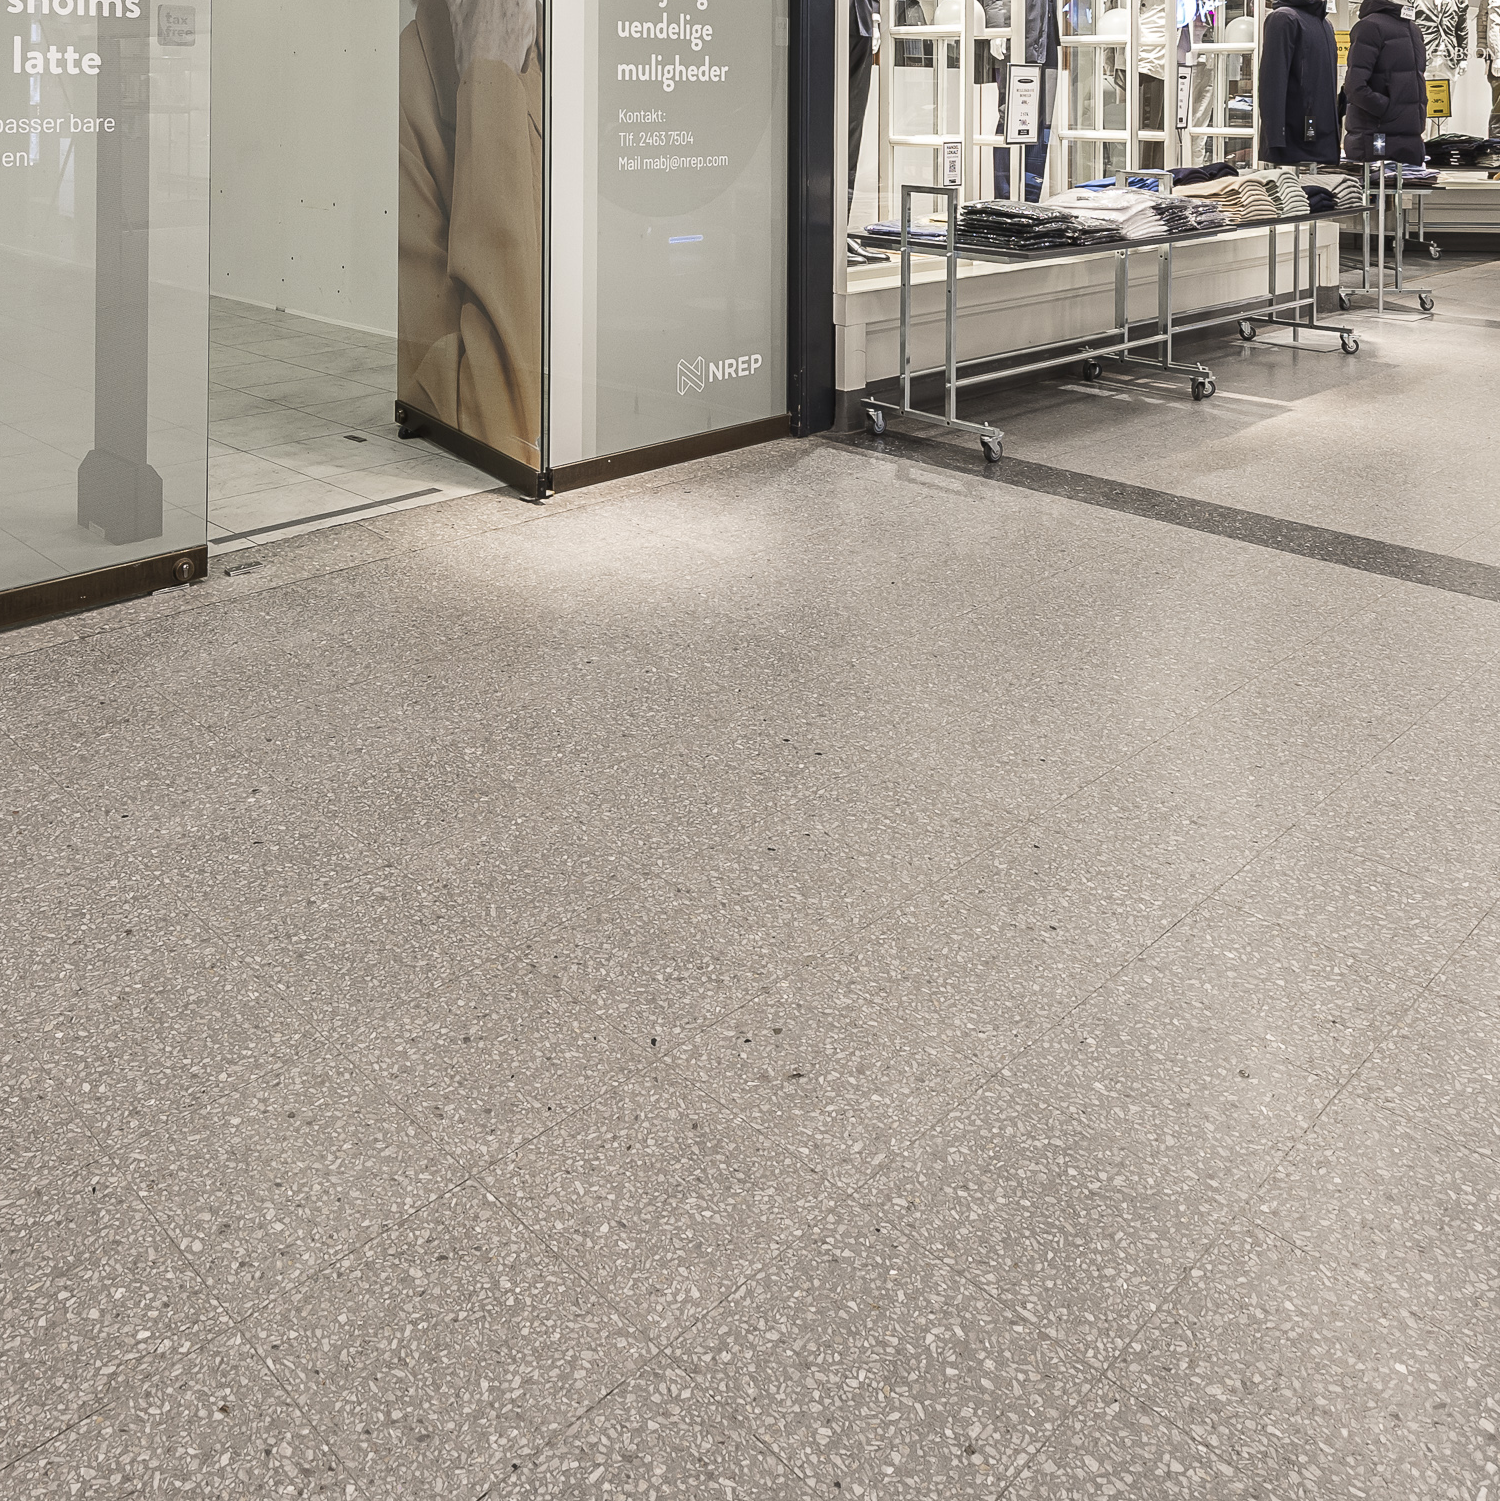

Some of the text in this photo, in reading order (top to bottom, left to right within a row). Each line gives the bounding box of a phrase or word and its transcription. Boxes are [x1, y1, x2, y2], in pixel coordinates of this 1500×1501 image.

[165, 12, 188, 25] tax
[164, 25, 194, 41] free
[617, 12, 713, 51] uendelige
[13, 36, 102, 75] latte
[617, 54, 729, 92] muligheder
[70, 114, 116, 133] bare
[618, 108, 667, 123] Kontakt:
[618, 131, 694, 147] Tlf. 2463 7504
[618, 155, 729, 173] Mail mabj@nrep.com
[708, 353, 762, 383] NREP
